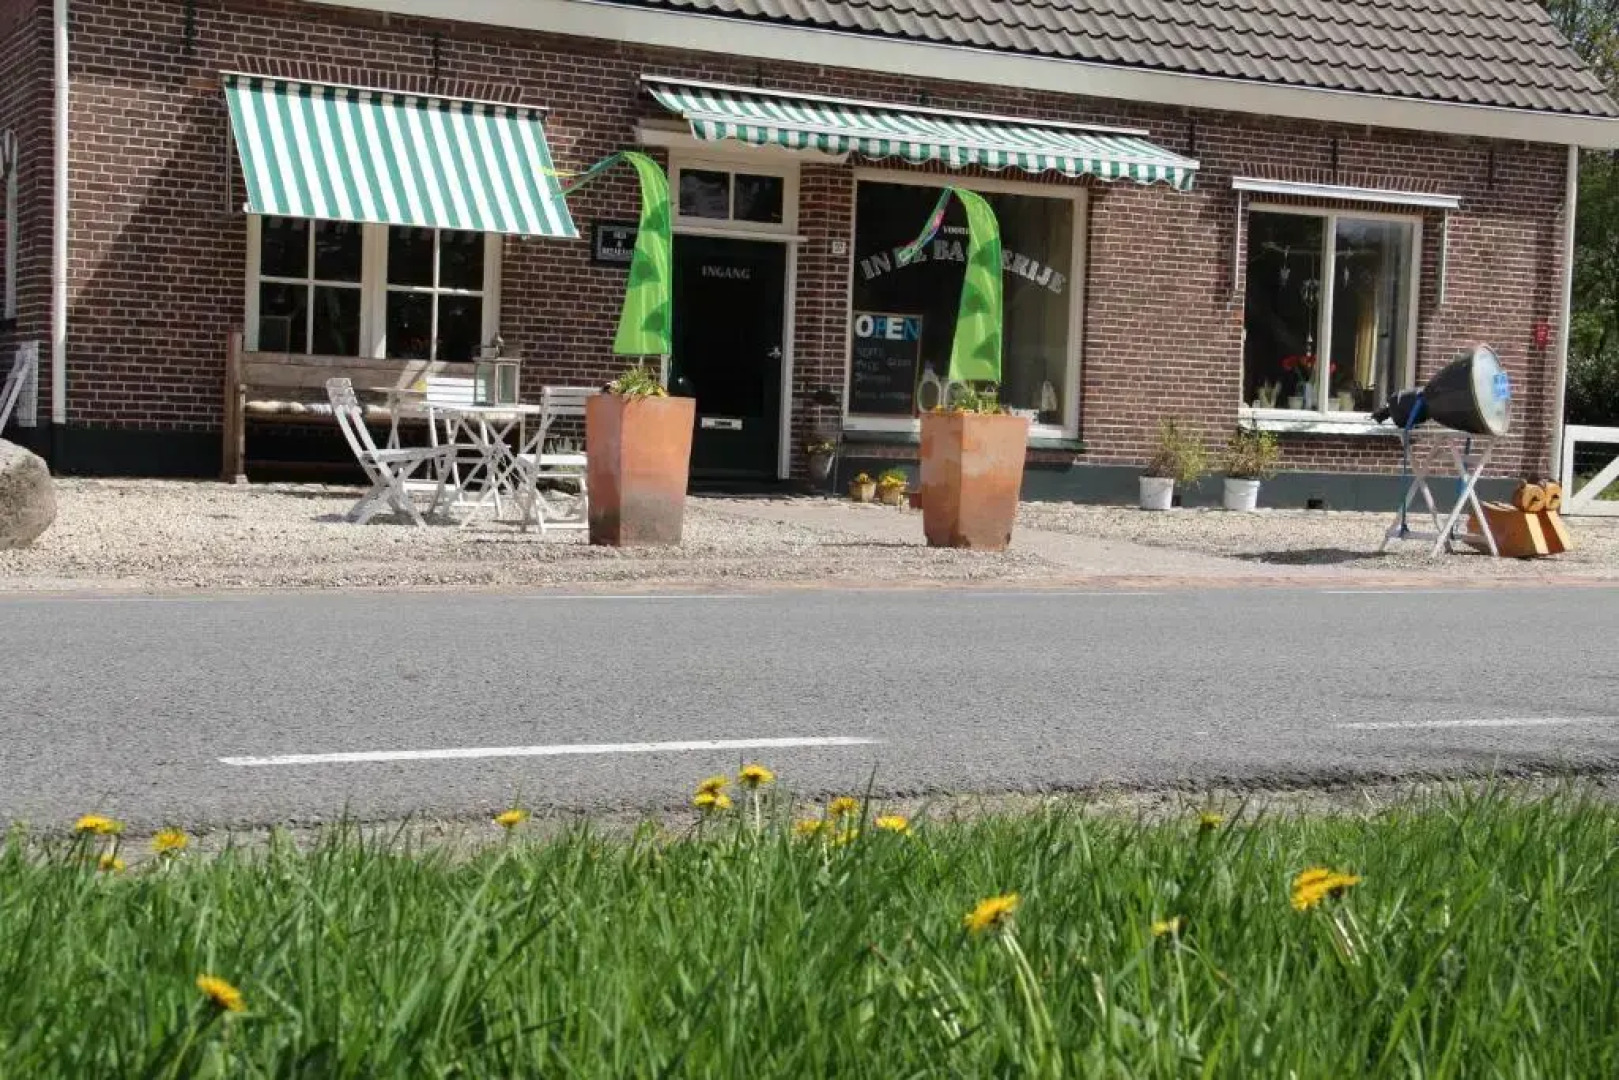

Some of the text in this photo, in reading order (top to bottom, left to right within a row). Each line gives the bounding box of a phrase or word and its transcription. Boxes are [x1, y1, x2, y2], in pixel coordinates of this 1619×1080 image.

[701, 264, 751, 279] INGANG
[860, 252, 891, 280] IN
[933, 239, 1067, 294] BAERIJE
[856, 315, 920, 341] OPEN
